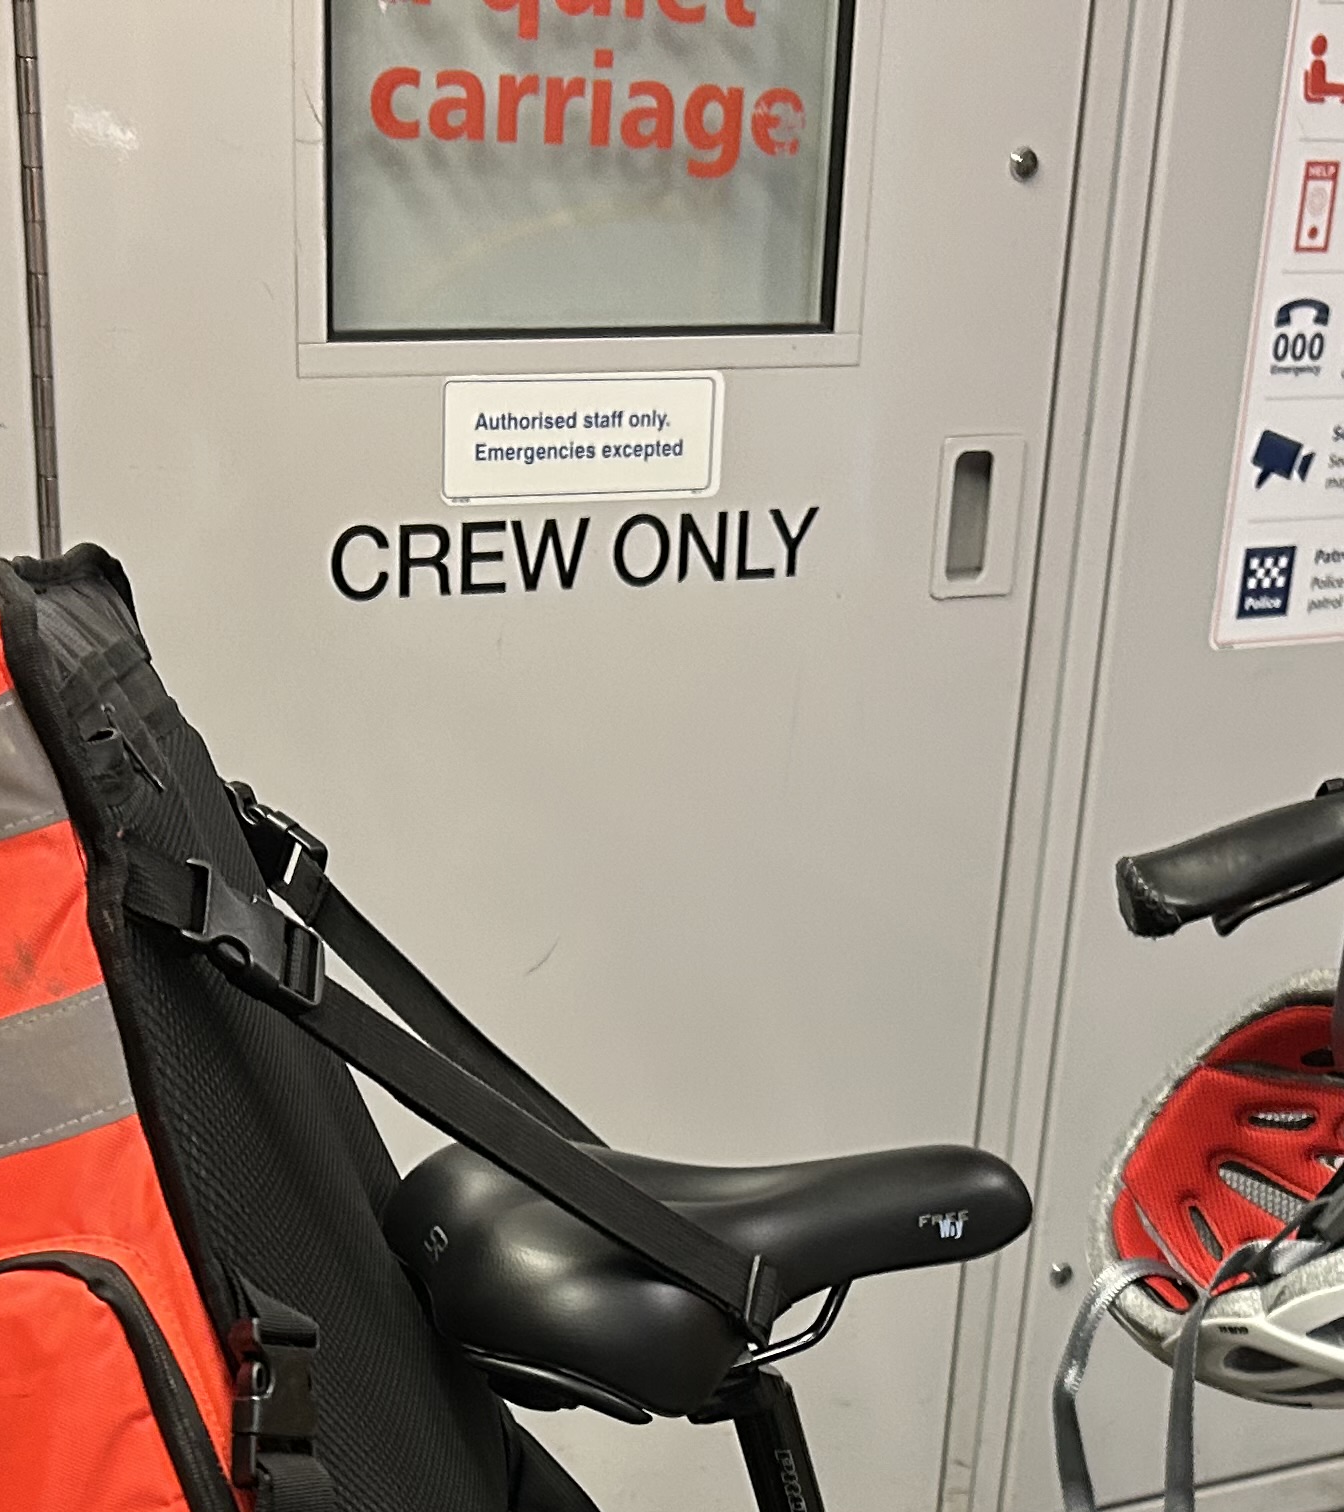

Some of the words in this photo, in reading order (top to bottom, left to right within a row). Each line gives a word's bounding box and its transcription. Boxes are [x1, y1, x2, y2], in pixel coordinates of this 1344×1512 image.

[370, 48, 806, 178] carriage
[1308, 165, 1337, 177] HELP
[1272, 332, 1324, 361] 000
[1270, 365, 1321, 377] Emergency
[474, 410, 577, 433] Authorised
[583, 409, 625, 431] staff
[628, 408, 671, 432] only.
[474, 440, 596, 466] Emergencies
[601, 438, 684, 463] excepted
[331, 516, 591, 602] CREW
[613, 506, 820, 588] ONLY
[1311, 575, 1344, 591] Police
[1243, 596, 1281, 611] Police
[1307, 597, 1343, 613] patrol
